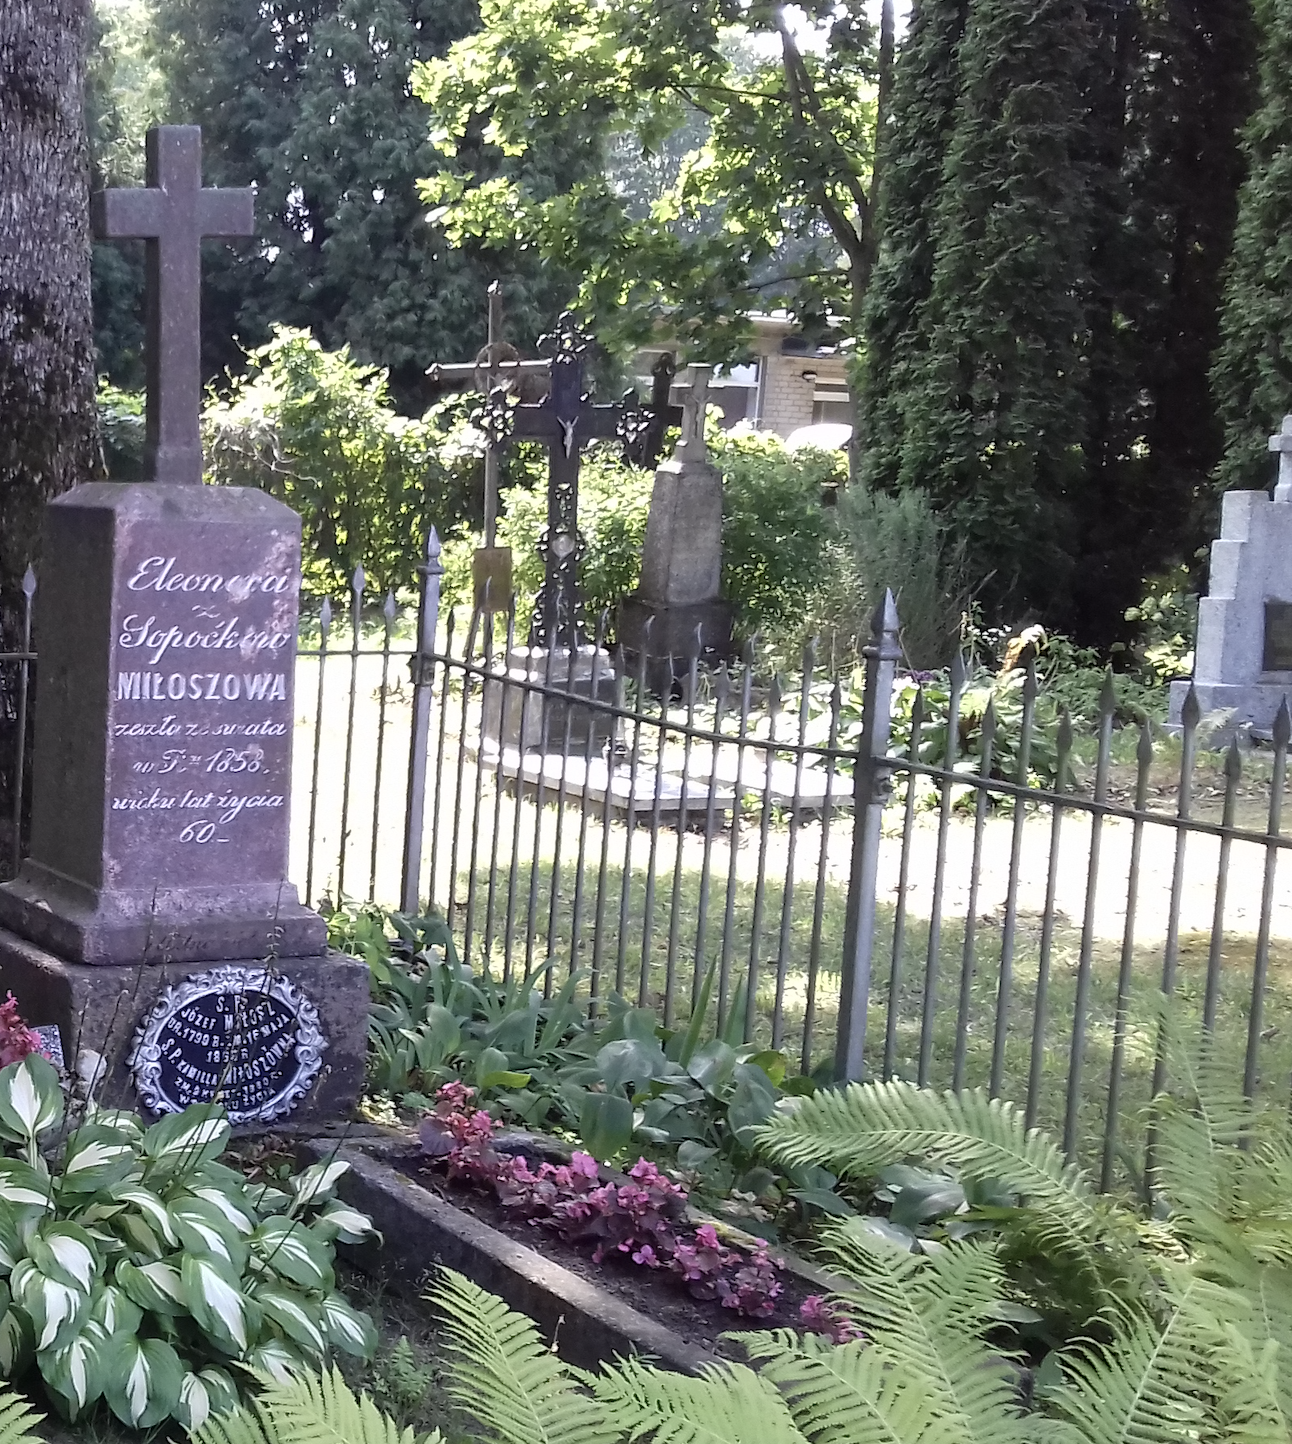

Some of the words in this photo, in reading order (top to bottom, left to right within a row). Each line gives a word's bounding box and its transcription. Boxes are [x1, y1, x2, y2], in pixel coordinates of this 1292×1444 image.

[127, 556, 290, 600] Eleonora
[117, 671, 287, 701] MIŁOSZOWA
[179, 789, 216, 809] lat
